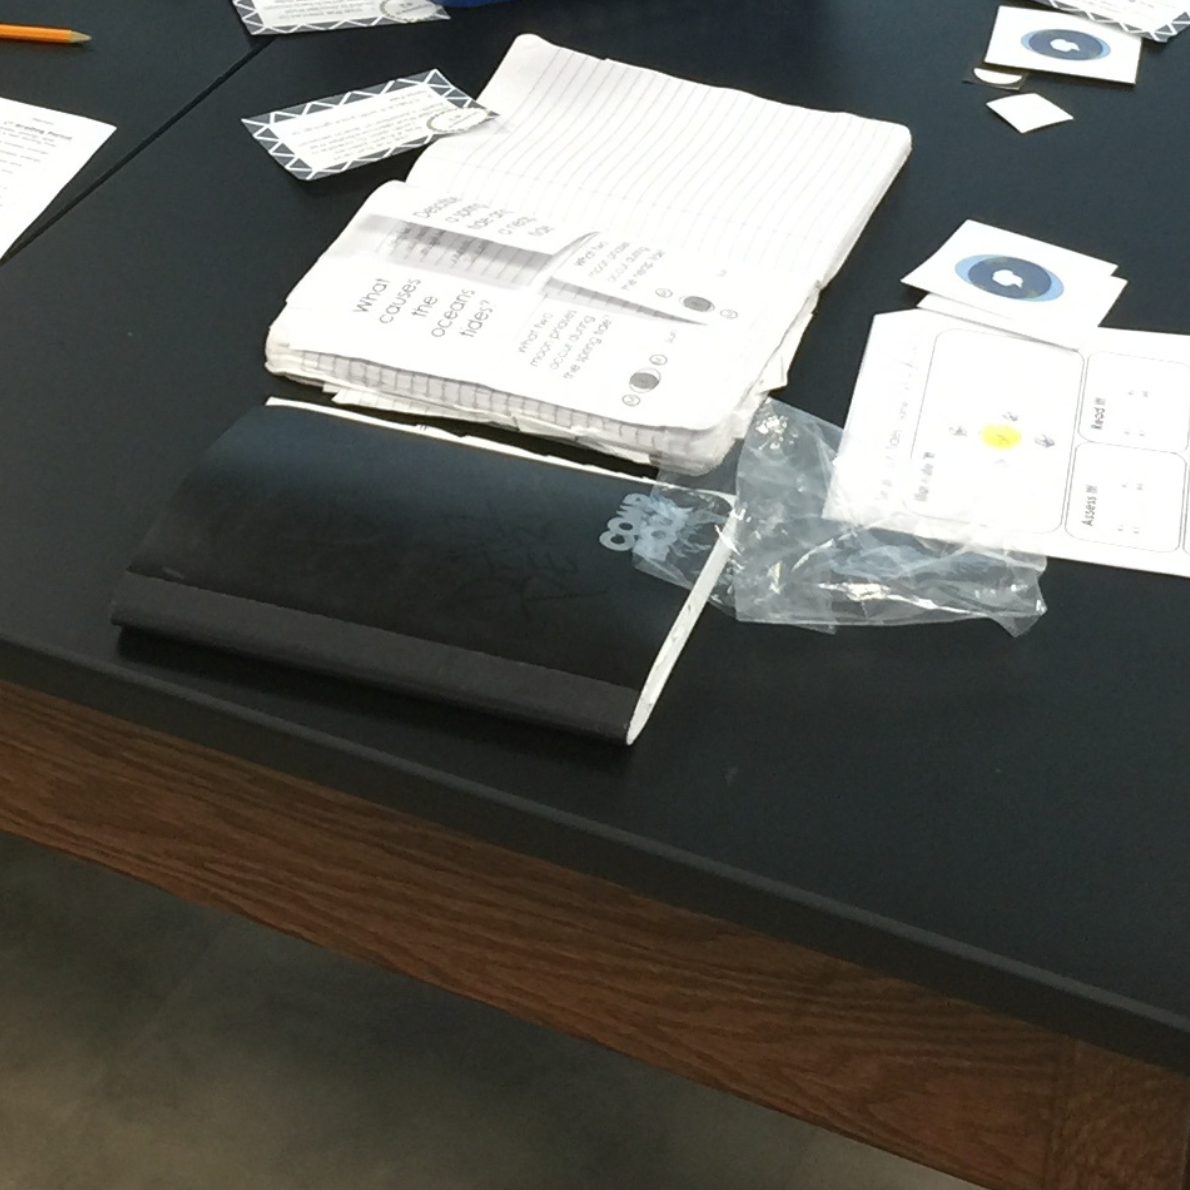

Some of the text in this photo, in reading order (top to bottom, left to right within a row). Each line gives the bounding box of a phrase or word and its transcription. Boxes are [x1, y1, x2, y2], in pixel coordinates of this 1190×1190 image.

[354, 278, 388, 312] What
[379, 279, 421, 323] causes
[411, 296, 437, 317] the
[431, 290, 475, 337] oceans
[459, 300, 493, 337] tides?
[1091, 407, 1106, 431] Read
[1081, 495, 1098, 528] Assess
